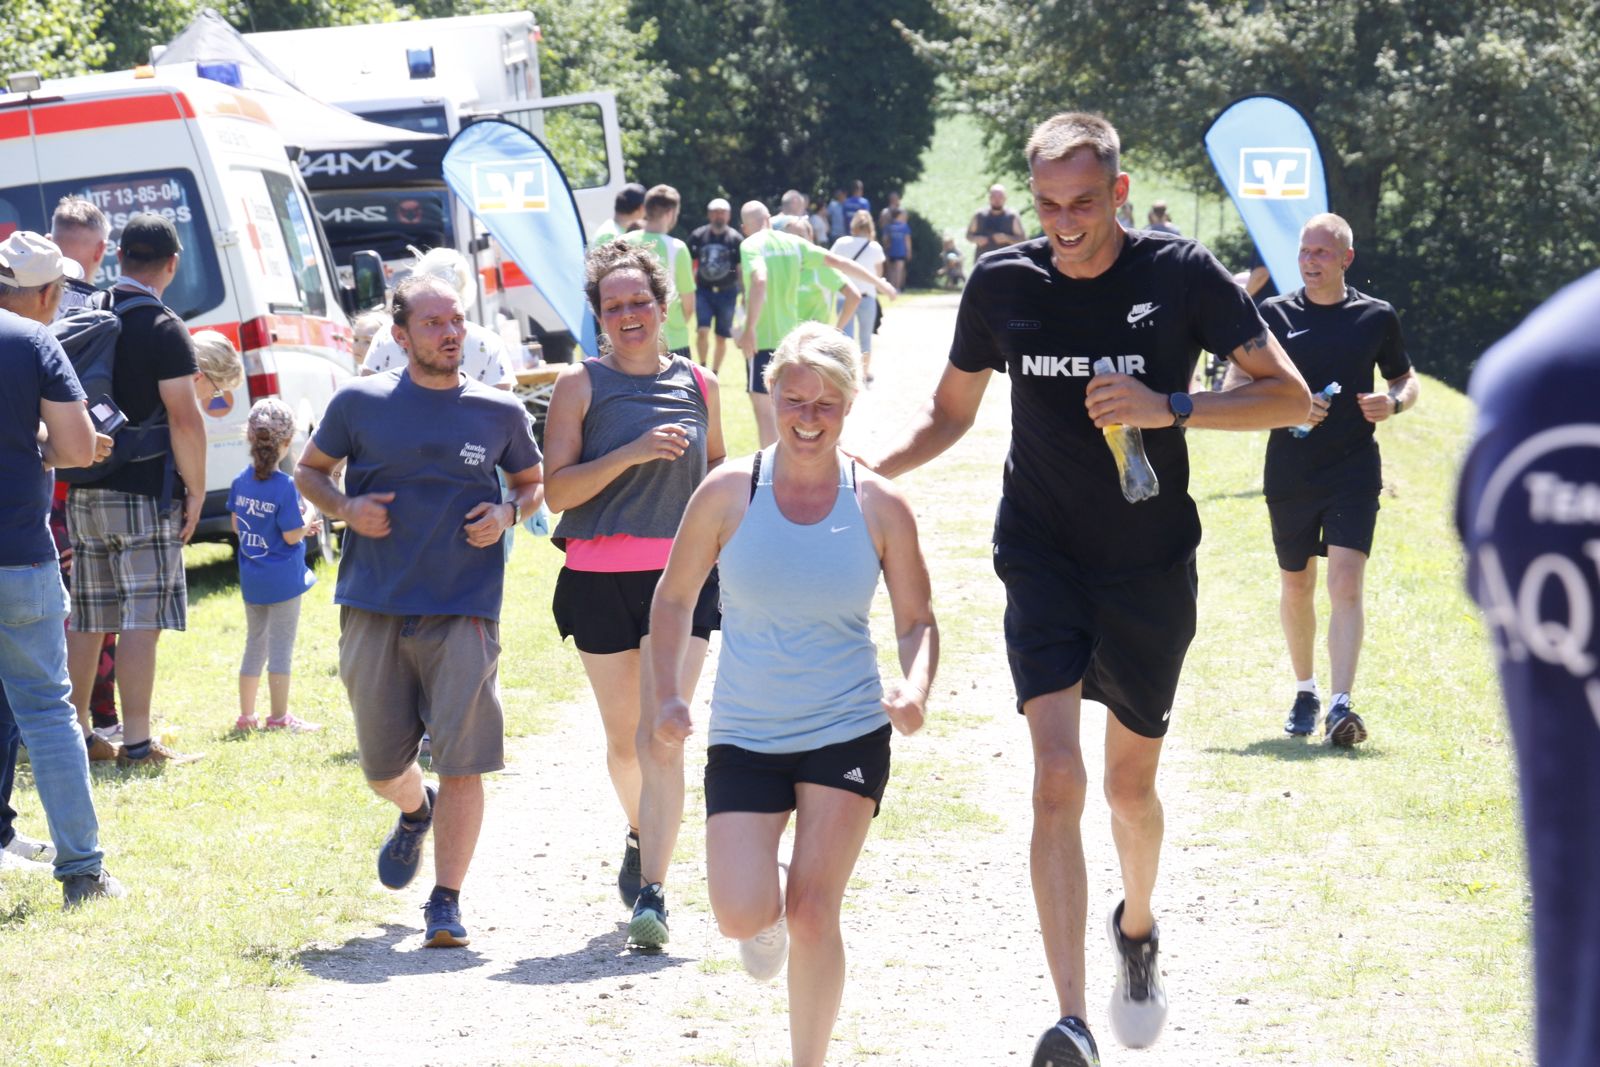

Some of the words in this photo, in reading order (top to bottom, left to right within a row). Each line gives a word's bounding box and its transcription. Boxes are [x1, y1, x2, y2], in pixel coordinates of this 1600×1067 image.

[1131, 302, 1153, 315] NIKE
[1131, 320, 1155, 329] AIR
[1022, 354, 1090, 377] NIKE
[1099, 354, 1147, 376] AIR
[843, 773, 865, 785] adidas
